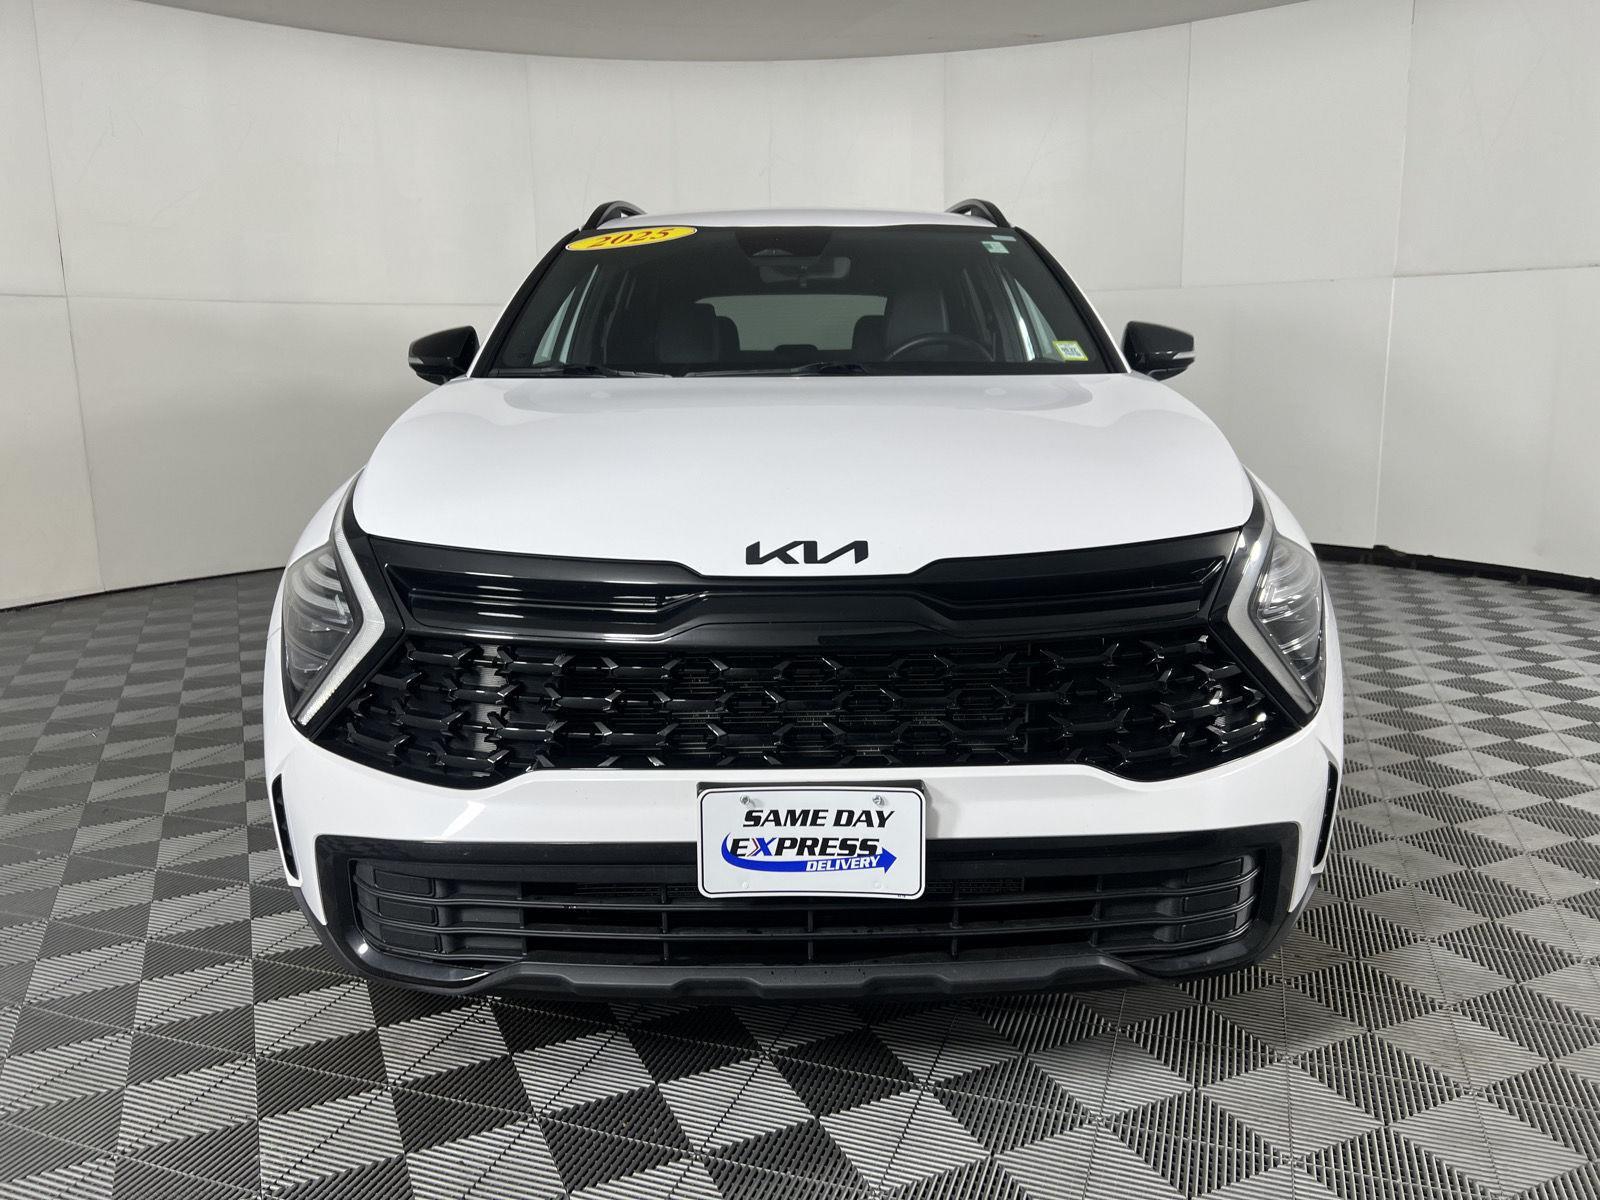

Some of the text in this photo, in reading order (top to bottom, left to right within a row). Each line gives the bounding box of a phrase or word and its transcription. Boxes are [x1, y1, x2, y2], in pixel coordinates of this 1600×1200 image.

[587, 228, 674, 248] 2025
[745, 540, 869, 565] KIA
[743, 809, 895, 828] SAME DAY
[729, 837, 880, 857] EXPRESS
[805, 856, 881, 872] DELIVERY
